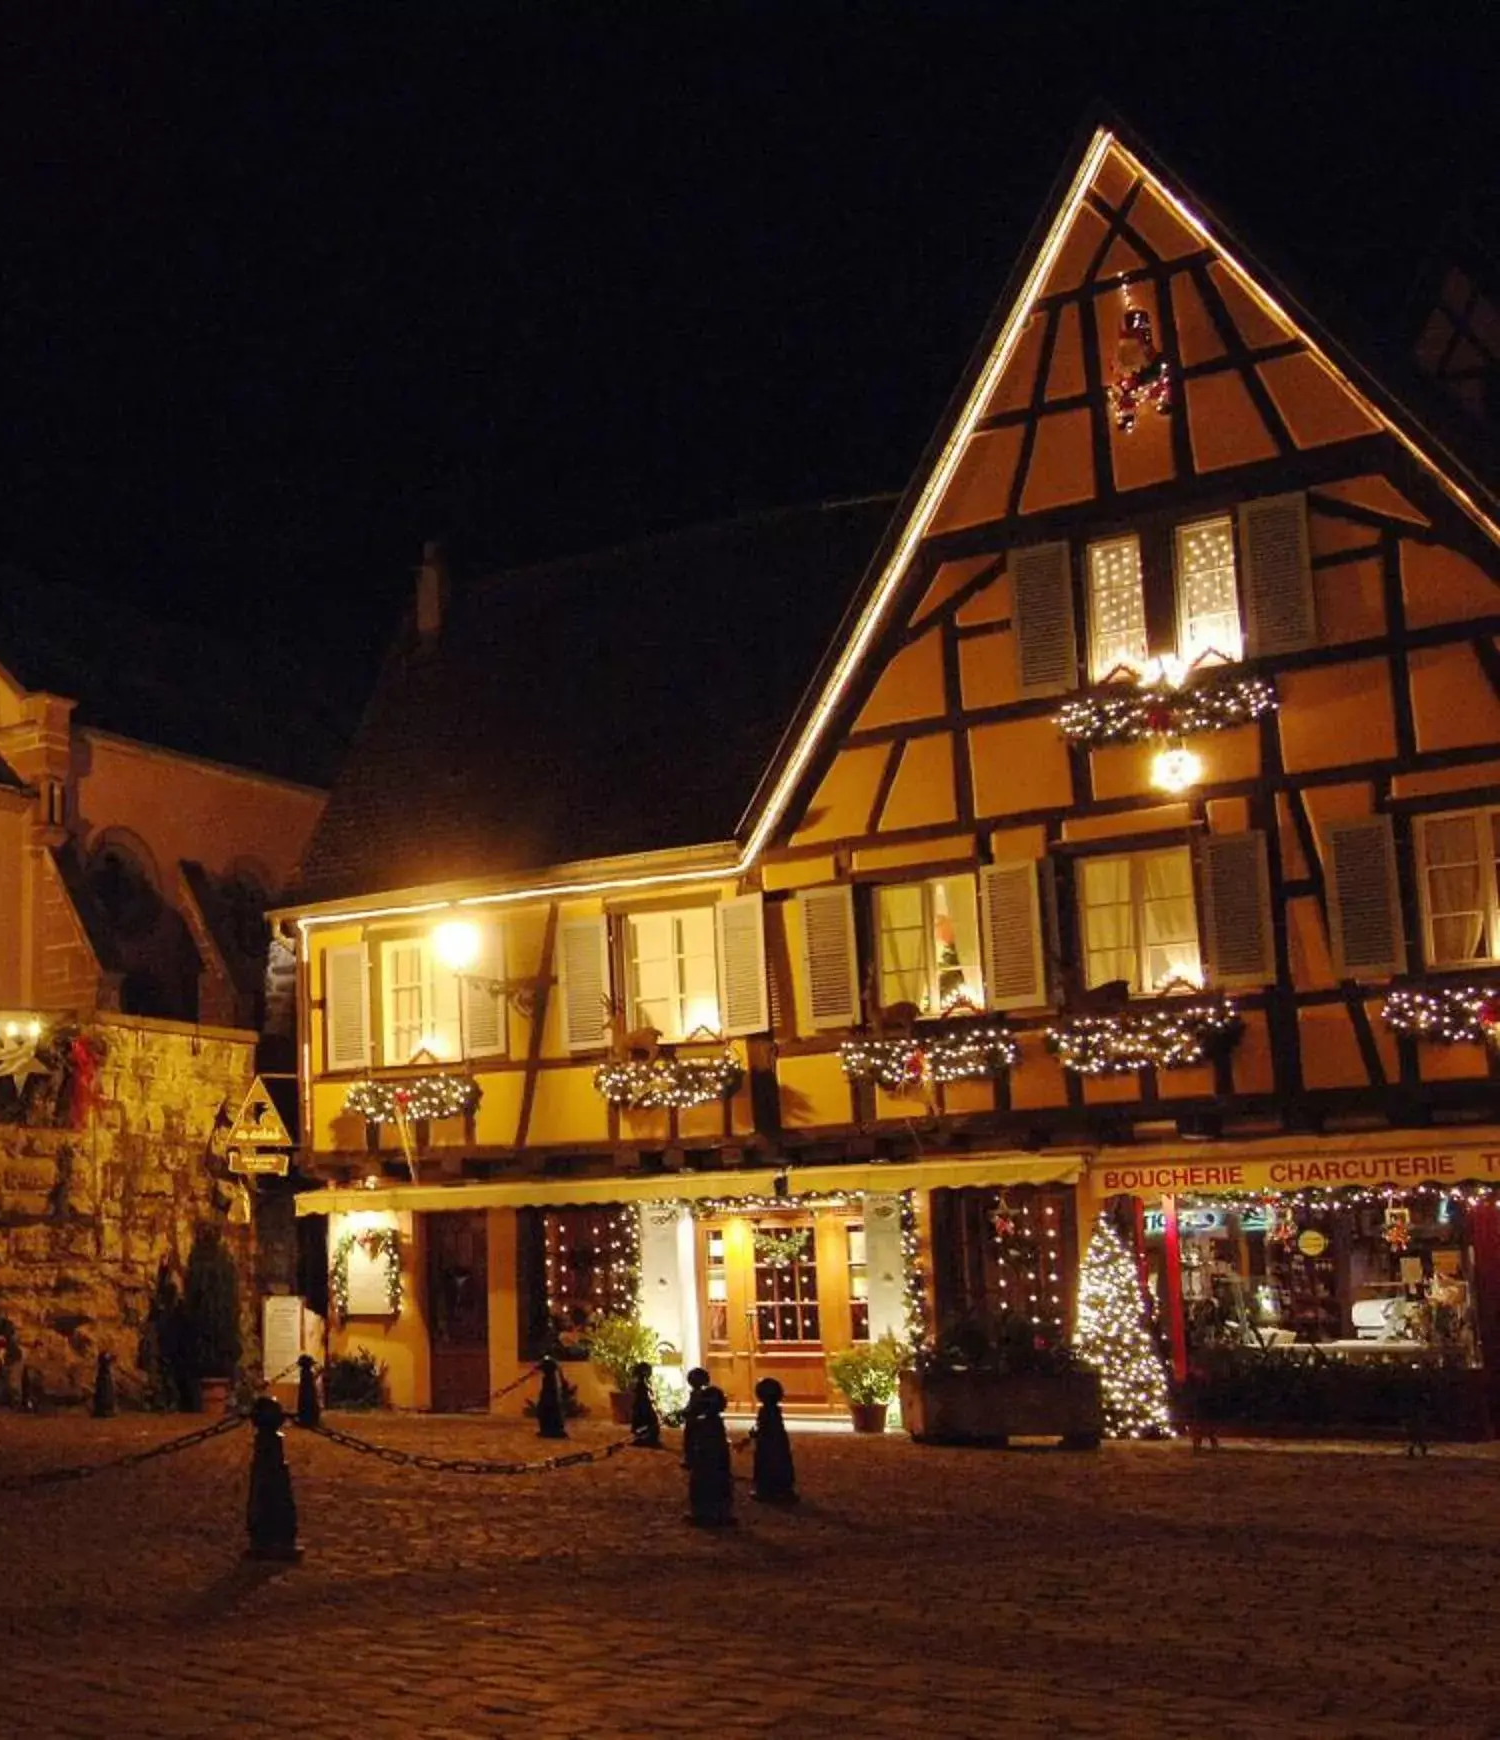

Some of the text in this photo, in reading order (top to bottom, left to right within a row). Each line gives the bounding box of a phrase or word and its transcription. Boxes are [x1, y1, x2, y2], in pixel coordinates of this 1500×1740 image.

[1104, 1154, 1500, 1189] BOUCHERIE CHARCUTERIE T
